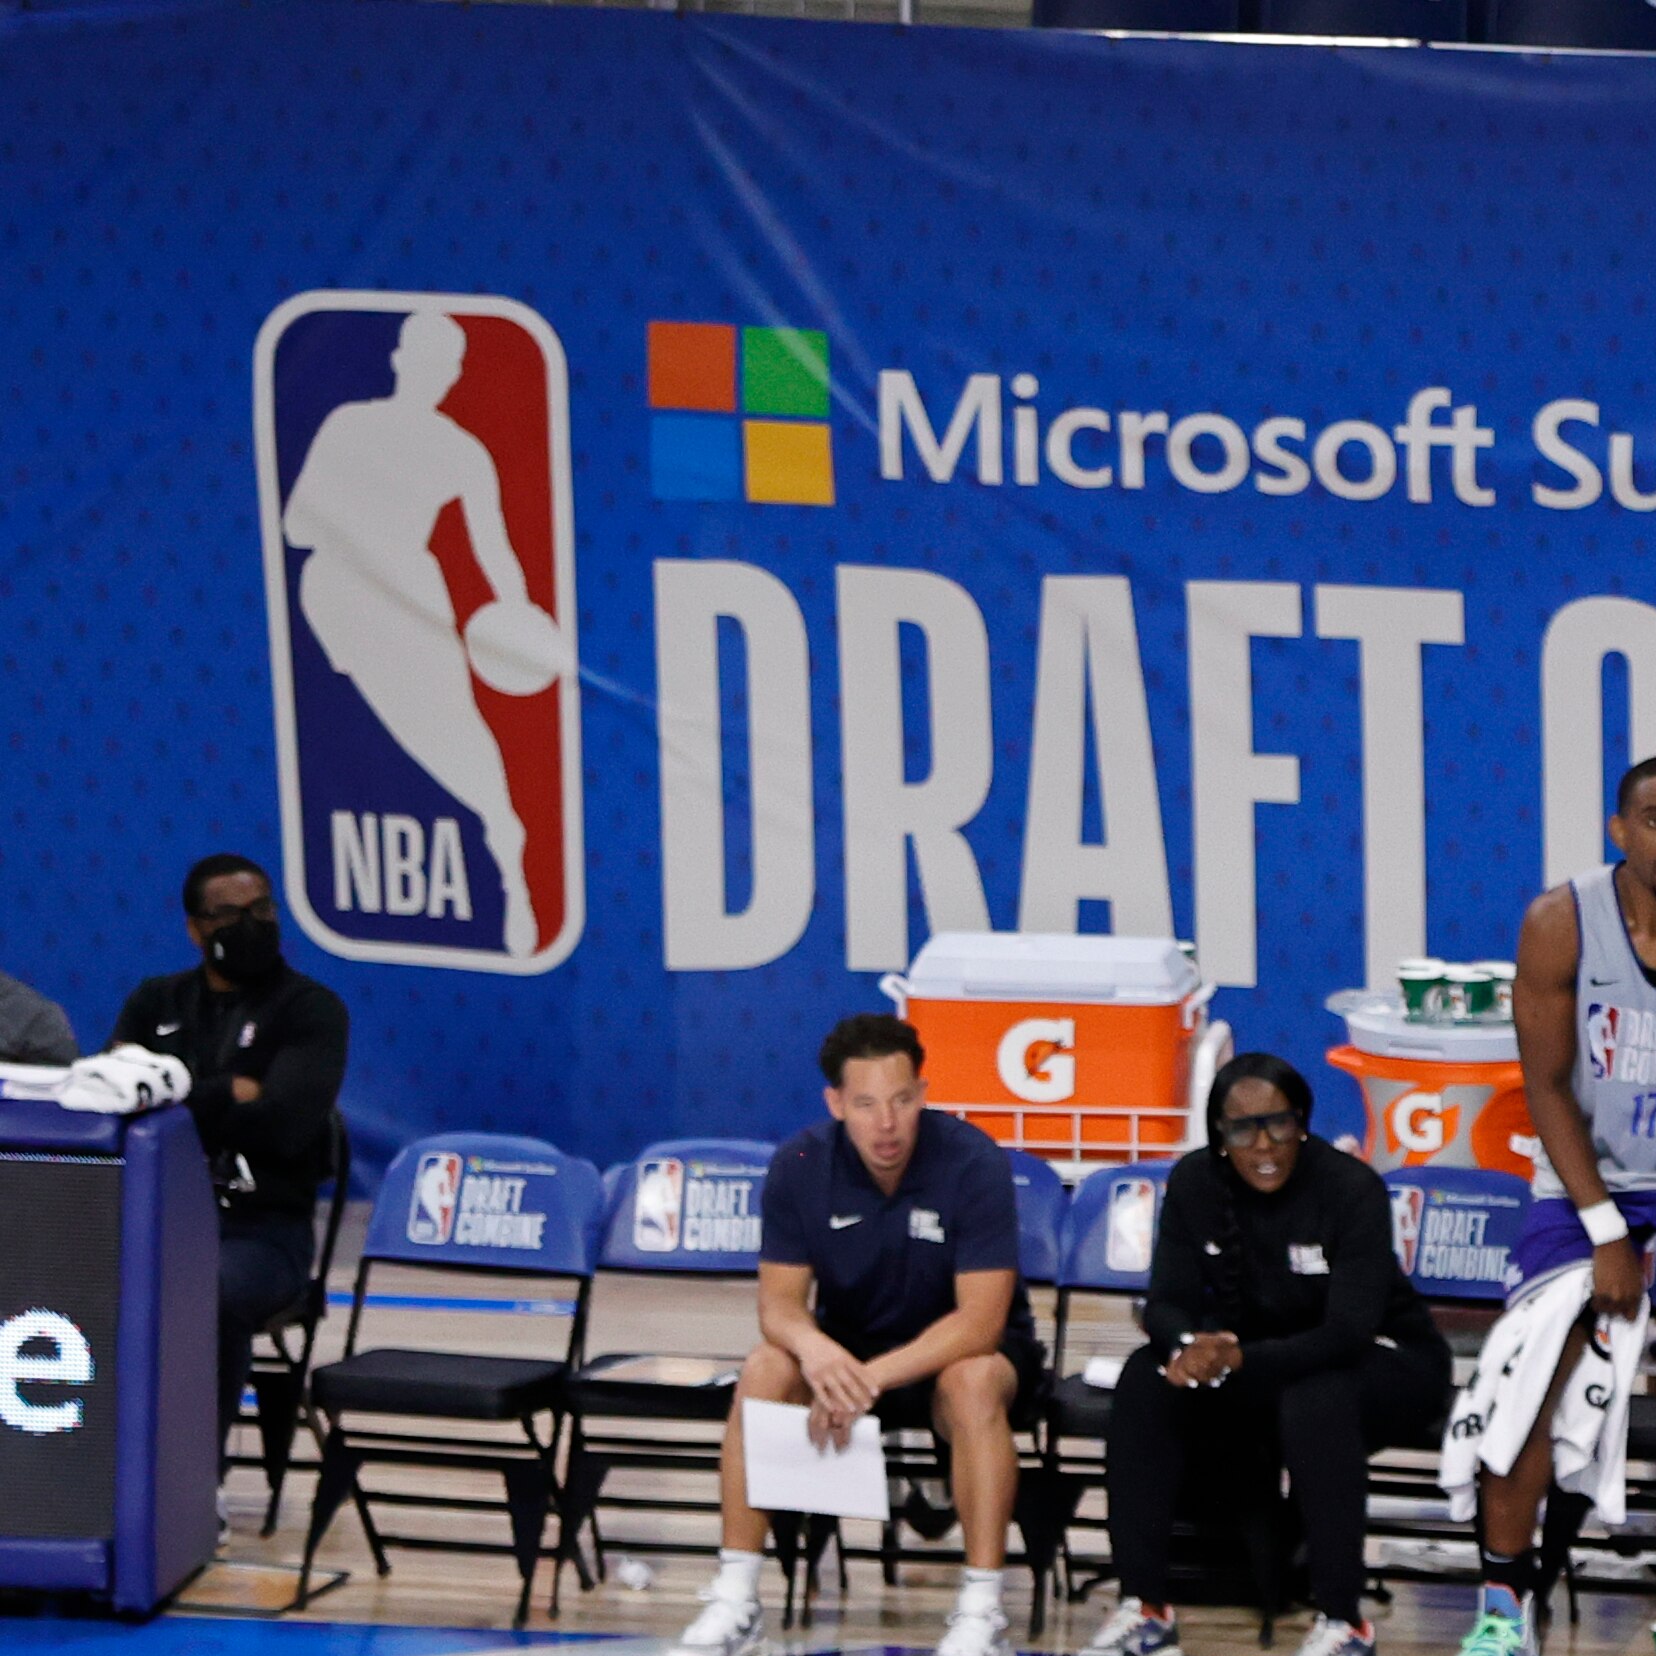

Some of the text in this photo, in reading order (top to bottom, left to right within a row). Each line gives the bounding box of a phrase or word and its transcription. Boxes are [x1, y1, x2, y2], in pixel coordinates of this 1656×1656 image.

[878, 369, 1496, 508] Microsoft
[653, 558, 1465, 990] DRAFT
[331, 810, 473, 921] NBA
[997, 1017, 1076, 1103] G
[1393, 1092, 1444, 1152] G
[1424, 1208, 1491, 1246] DRAFT
